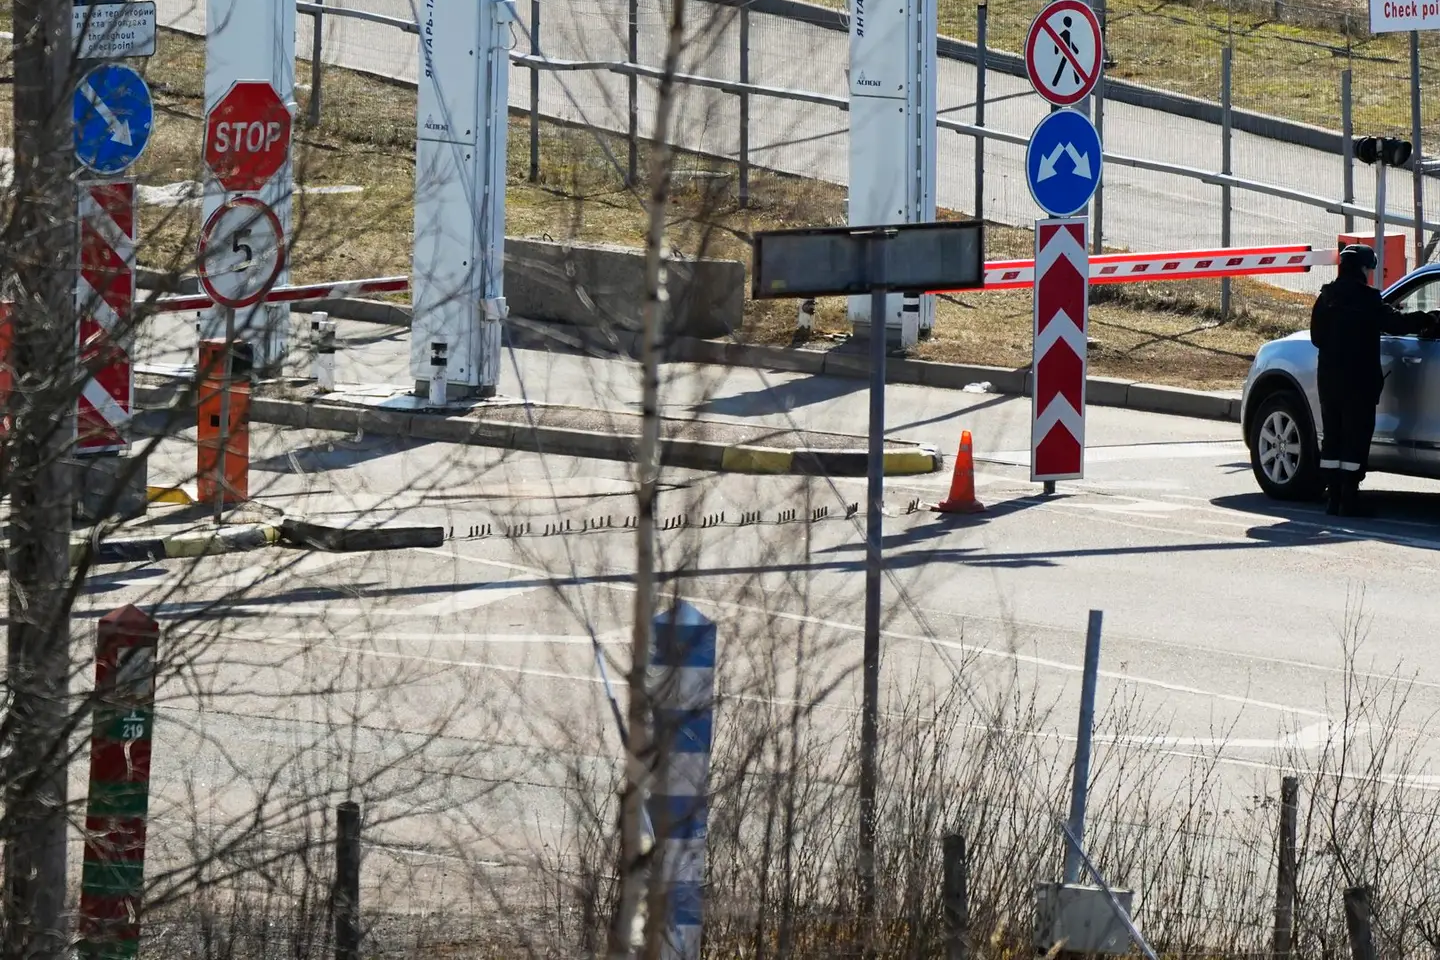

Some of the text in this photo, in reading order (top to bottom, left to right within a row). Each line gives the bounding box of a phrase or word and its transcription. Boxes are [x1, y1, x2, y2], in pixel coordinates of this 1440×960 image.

[1384, 1, 1418, 19] Check
[214, 121, 281, 153] STOP
[232, 228, 252, 273] 5
